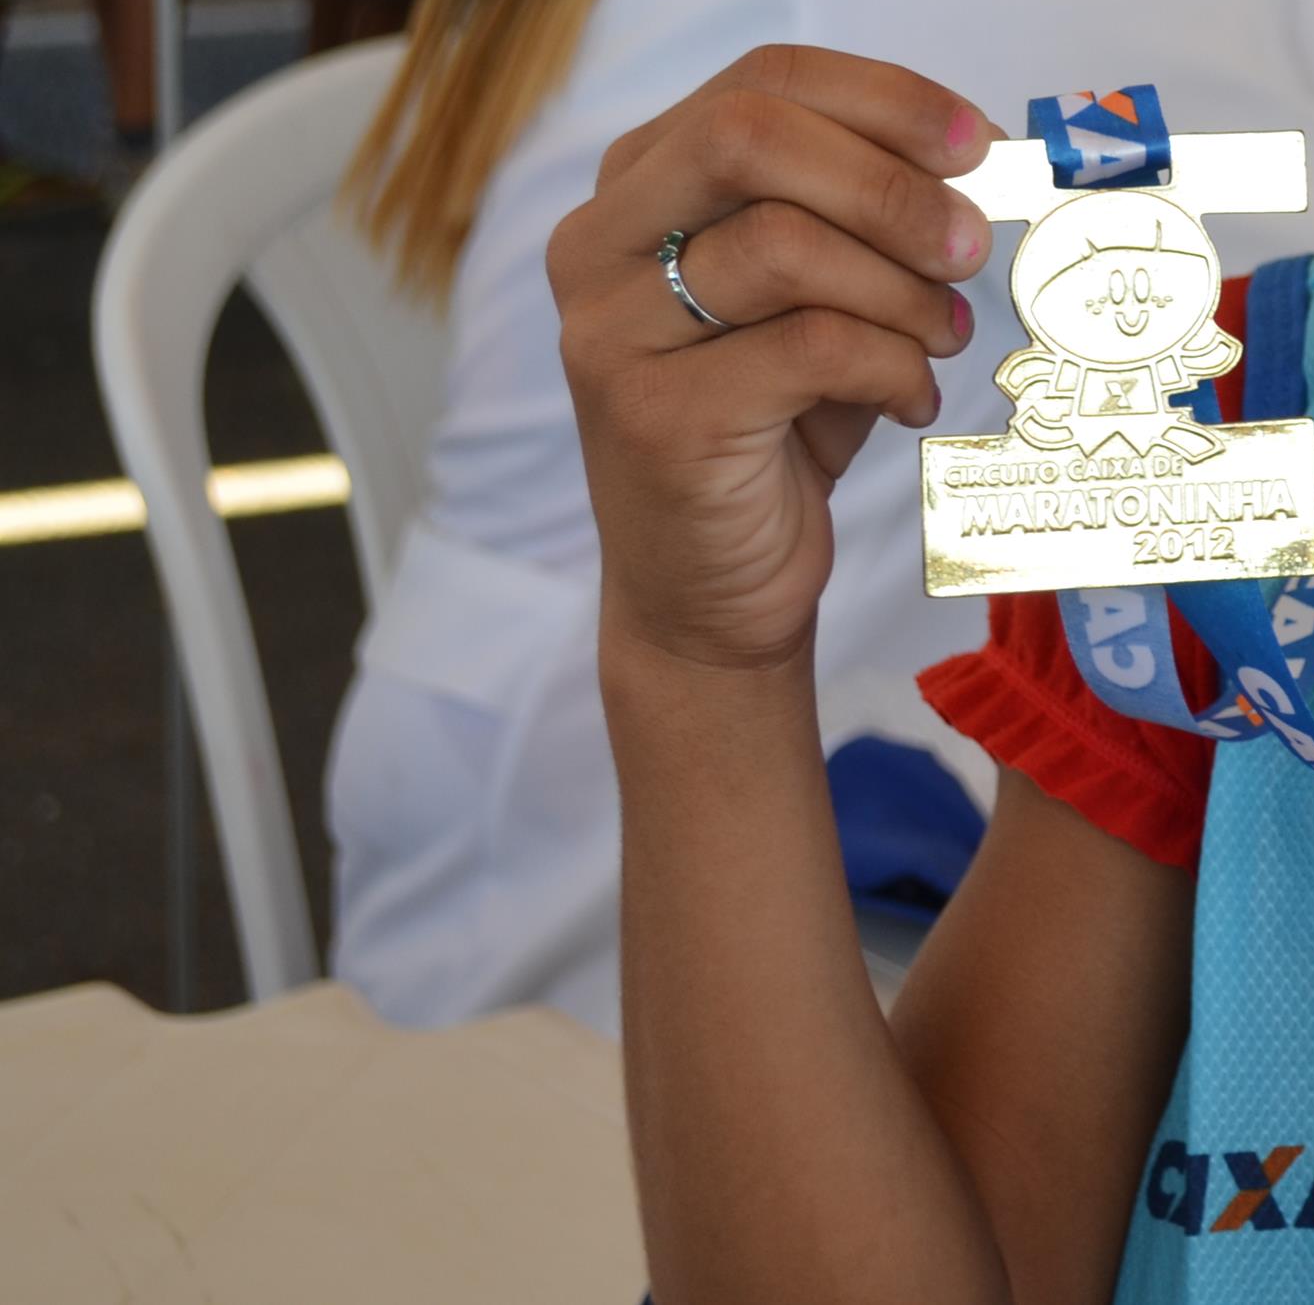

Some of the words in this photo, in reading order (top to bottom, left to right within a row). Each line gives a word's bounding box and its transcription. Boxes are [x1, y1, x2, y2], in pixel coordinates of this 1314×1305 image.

[943, 461, 1060, 489] CIRCUITO
[1066, 456, 1145, 482] CAIXA
[1153, 454, 1183, 477] DE
[960, 479, 1298, 537] MARATONINHA
[1132, 527, 1236, 565] 2012
